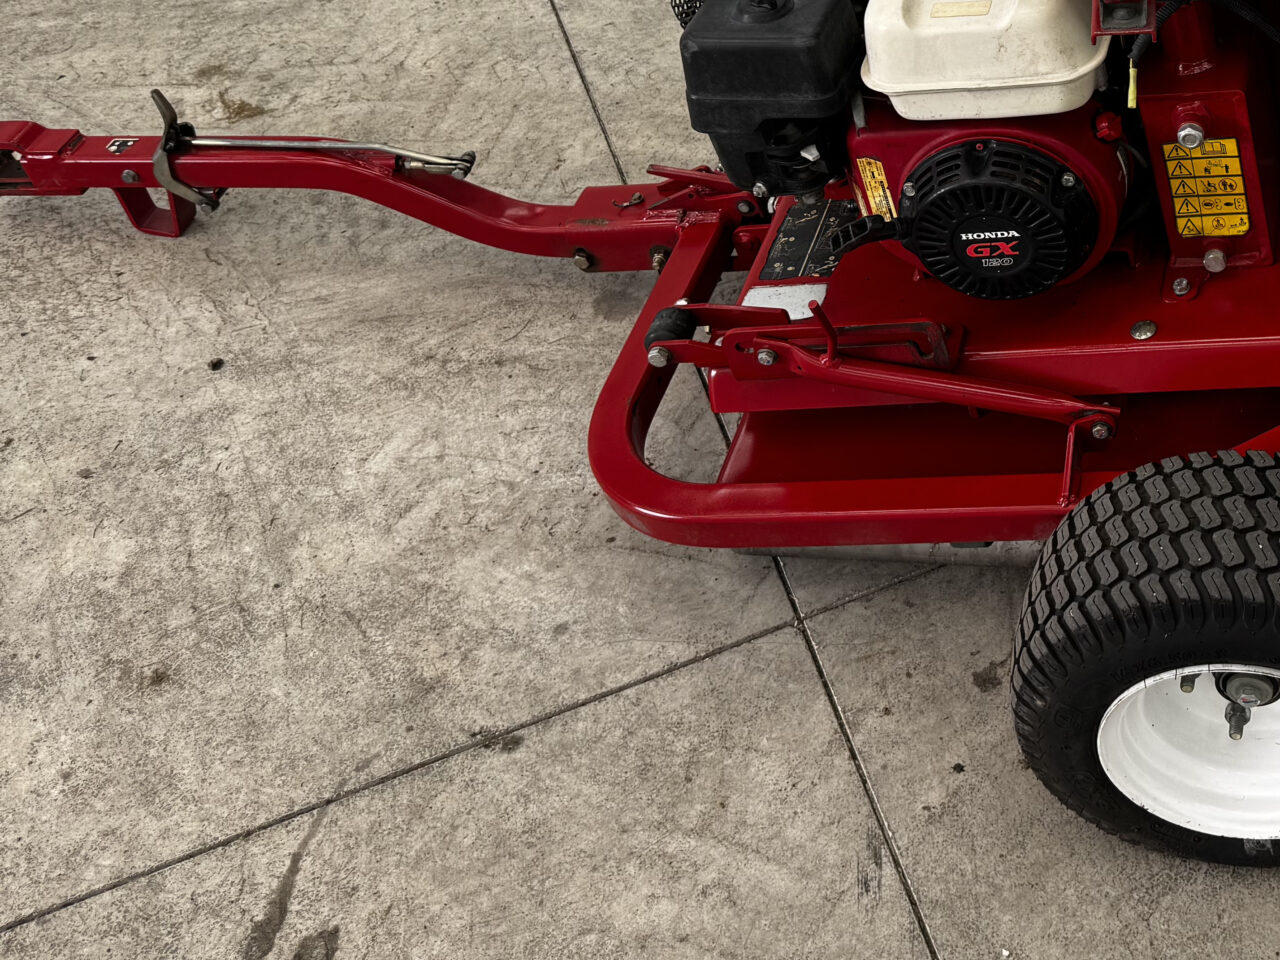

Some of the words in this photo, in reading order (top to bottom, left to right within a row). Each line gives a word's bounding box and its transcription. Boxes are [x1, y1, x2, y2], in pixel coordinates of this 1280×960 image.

[960, 230, 1021, 240] HONDA
[966, 241, 1019, 257] GX
[982, 257, 1014, 266] 120
